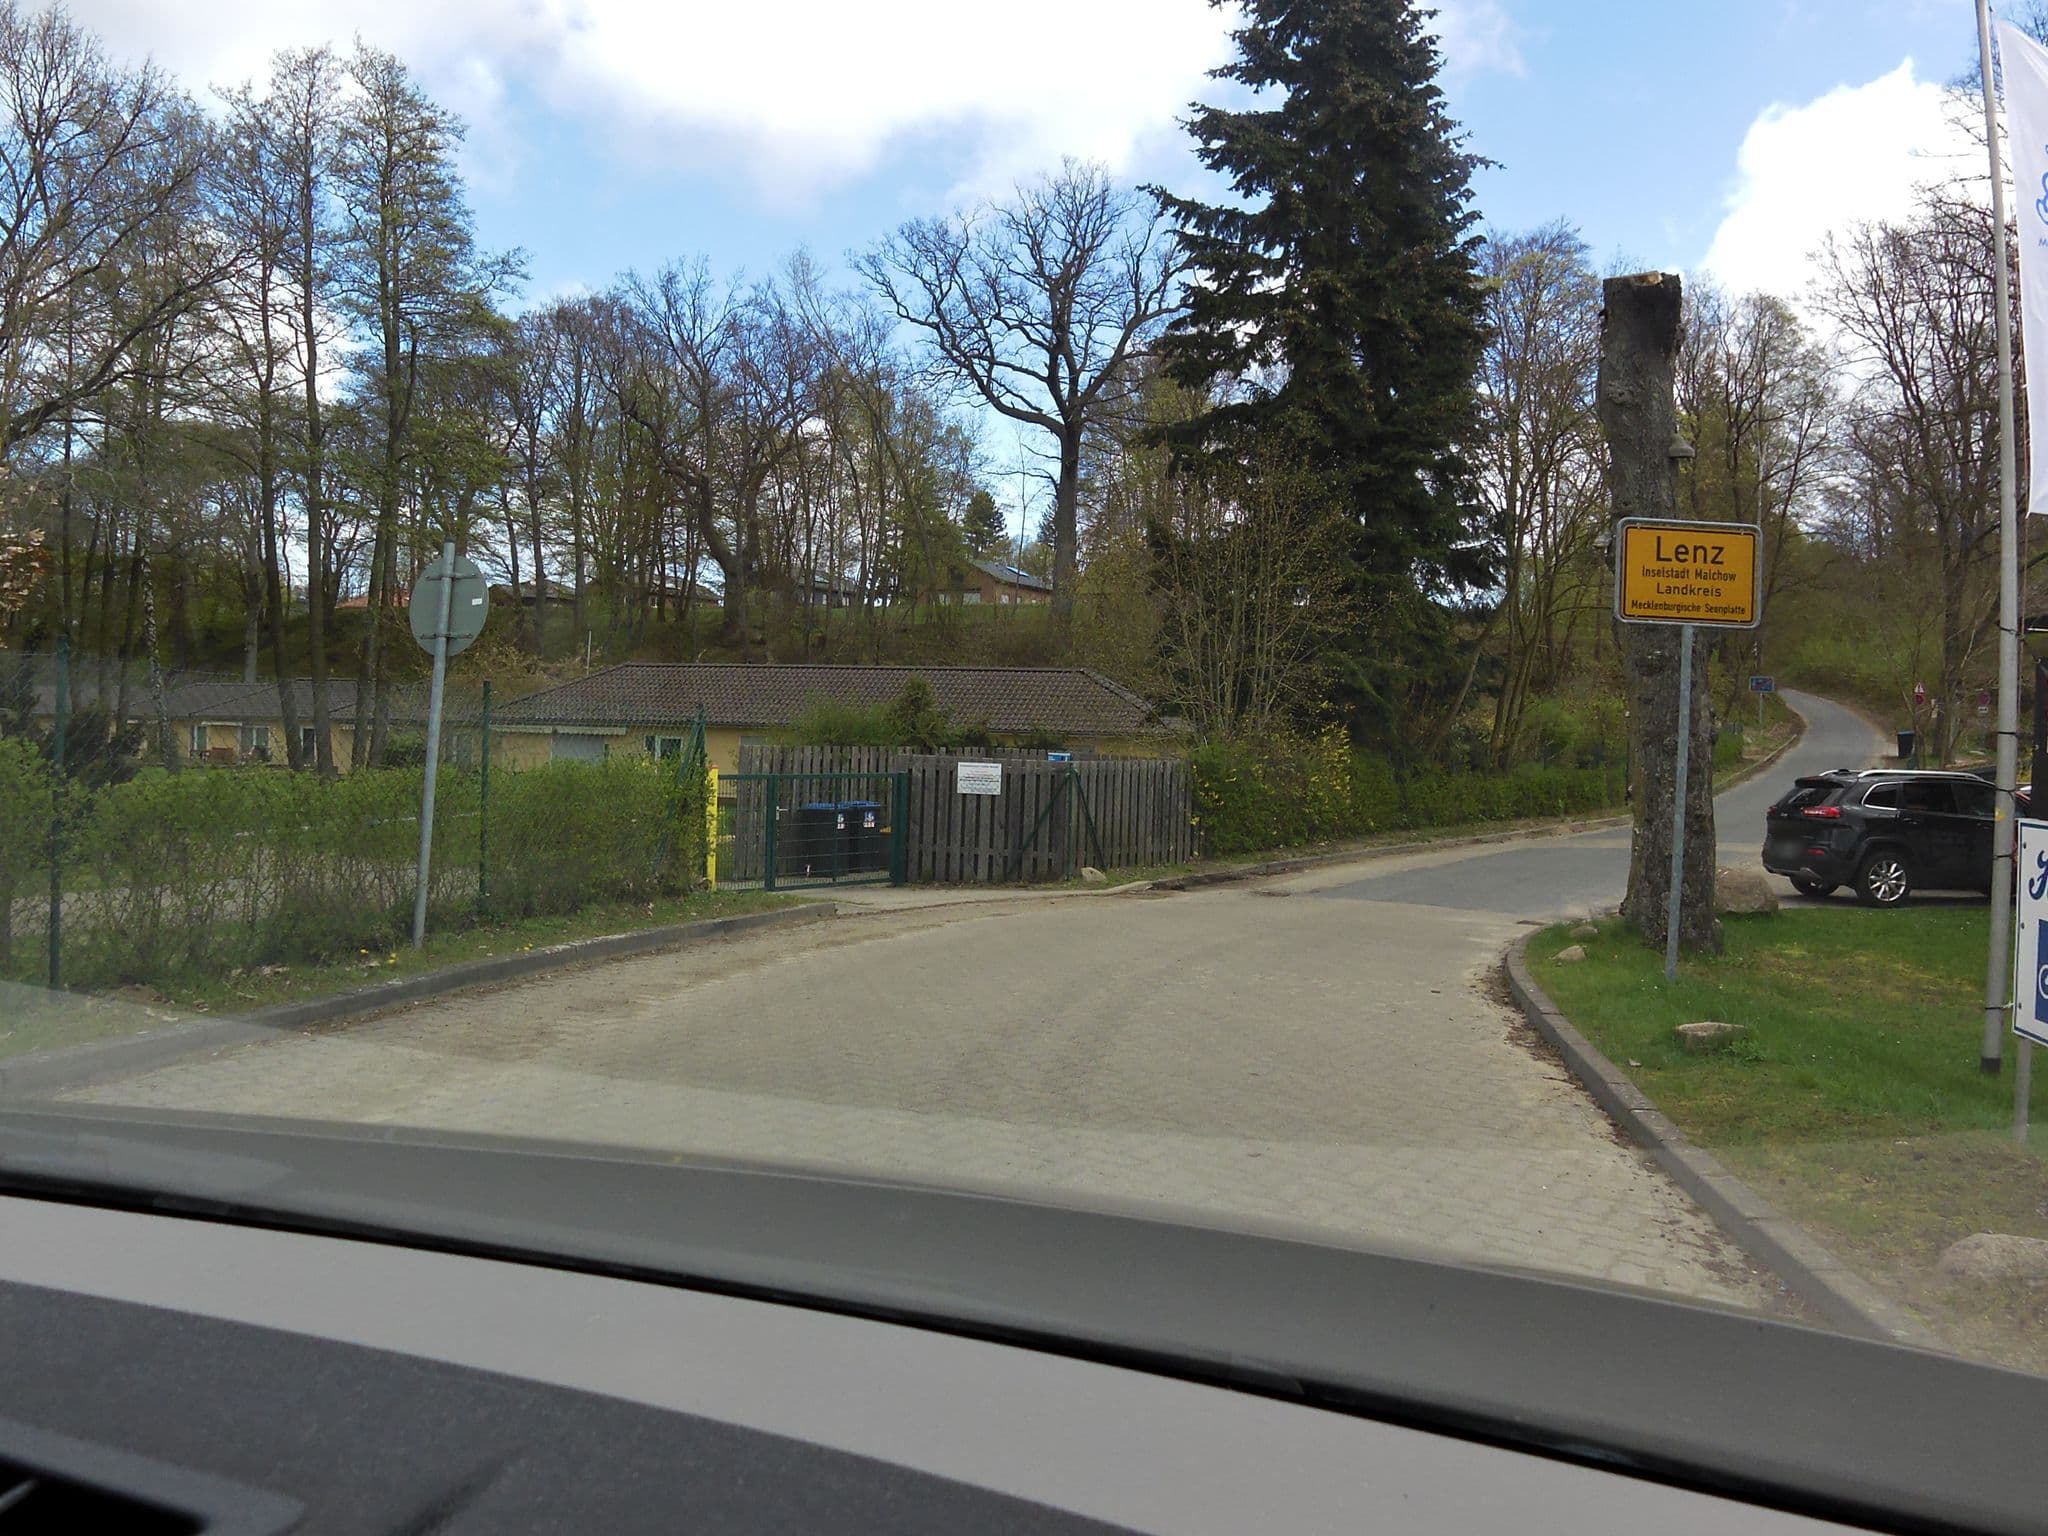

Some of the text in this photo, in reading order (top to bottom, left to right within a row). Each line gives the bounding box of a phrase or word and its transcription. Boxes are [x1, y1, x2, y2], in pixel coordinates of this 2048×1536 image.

[1656, 536, 1725, 565] Lenz
[1642, 565, 1737, 582] Inselstadt Malchow
[1656, 583, 1722, 597] Landkreis
[1631, 600, 1745, 616] Mecklenburgische Seenplatte
